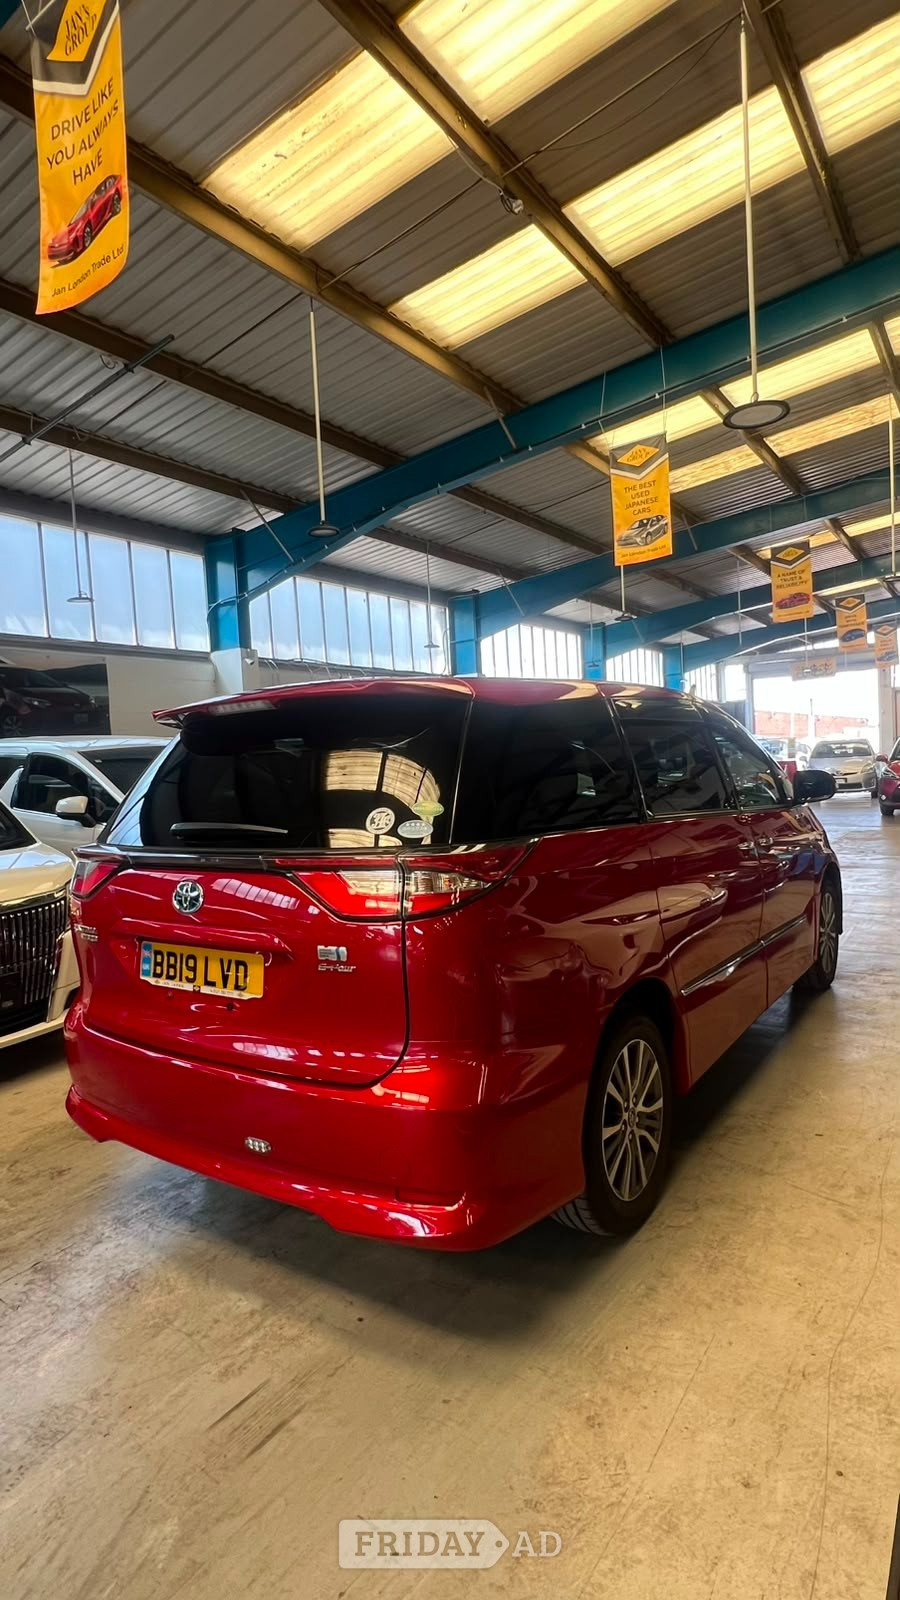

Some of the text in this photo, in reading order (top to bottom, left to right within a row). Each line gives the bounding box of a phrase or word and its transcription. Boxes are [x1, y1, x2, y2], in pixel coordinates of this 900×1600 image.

[65, 14, 97, 56] GROUP
[51, 76, 114, 141] DRIVE LIKE
[46, 99, 119, 170] YOU ALWAYS
[72, 147, 103, 185] HAVE
[51, 243, 124, 297] Jan London Trade Ltd
[624, 480, 656, 493] THE BEST
[624, 496, 659, 510] JAPANESE
[630, 489, 650, 500] USED
[632, 506, 652, 516] CARS
[152, 949, 249, 992] BB19 LVD
